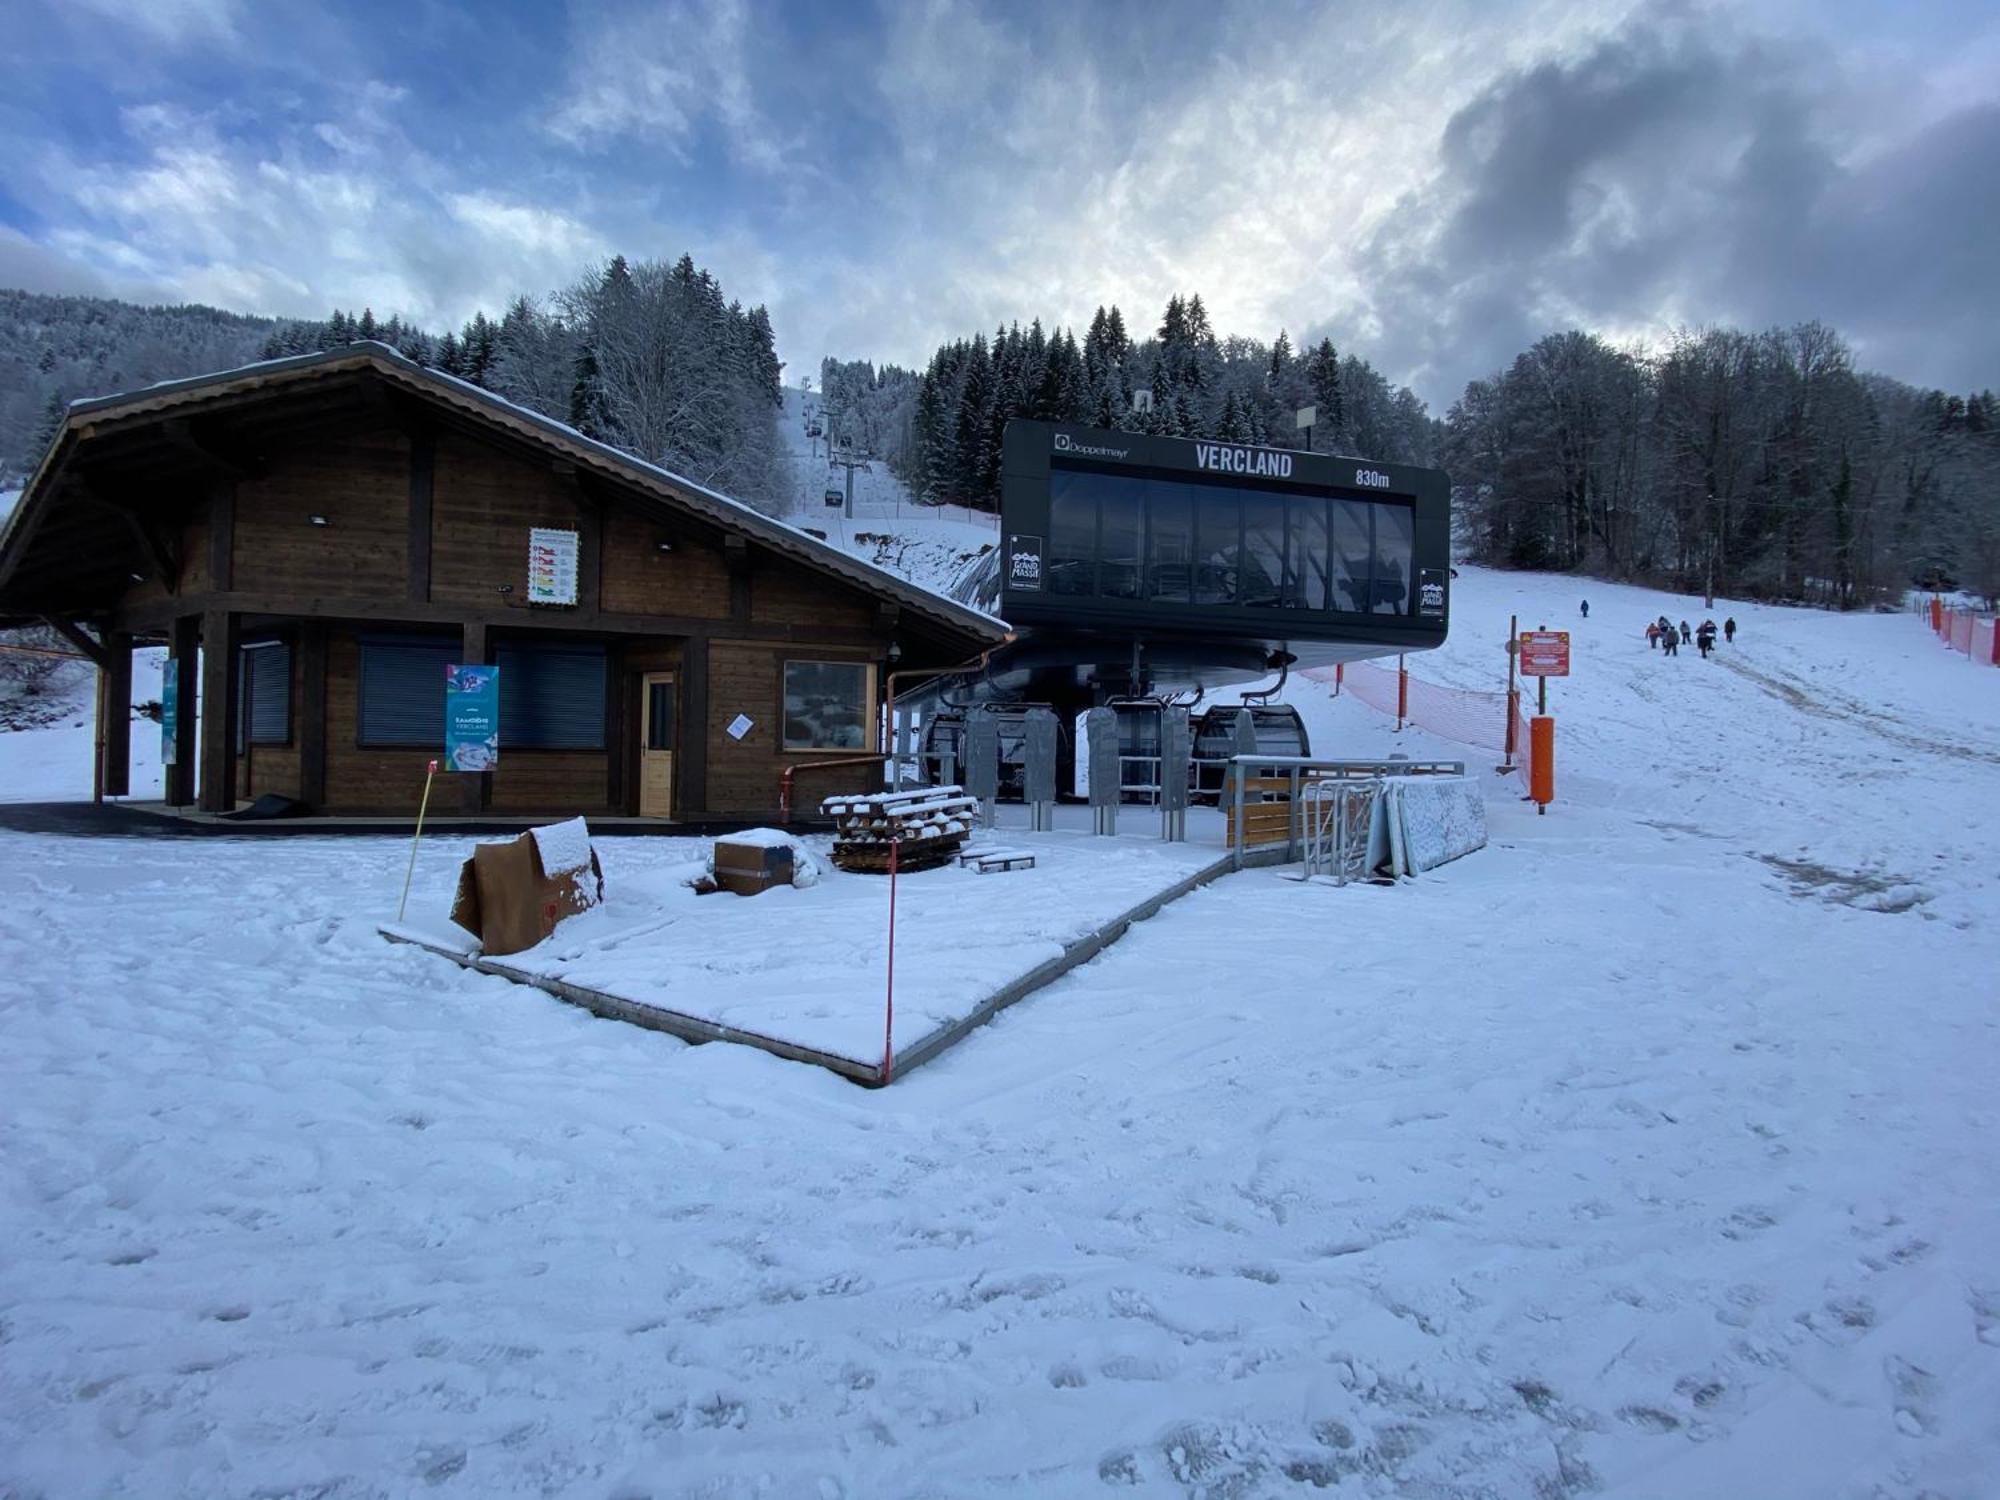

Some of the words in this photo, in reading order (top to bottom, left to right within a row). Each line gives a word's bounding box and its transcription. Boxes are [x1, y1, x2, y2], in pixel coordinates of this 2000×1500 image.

[1070, 441, 1129, 459] Doppelmayr
[1196, 445, 1292, 477] VERCLAND
[1355, 469, 1390, 488] 830m
